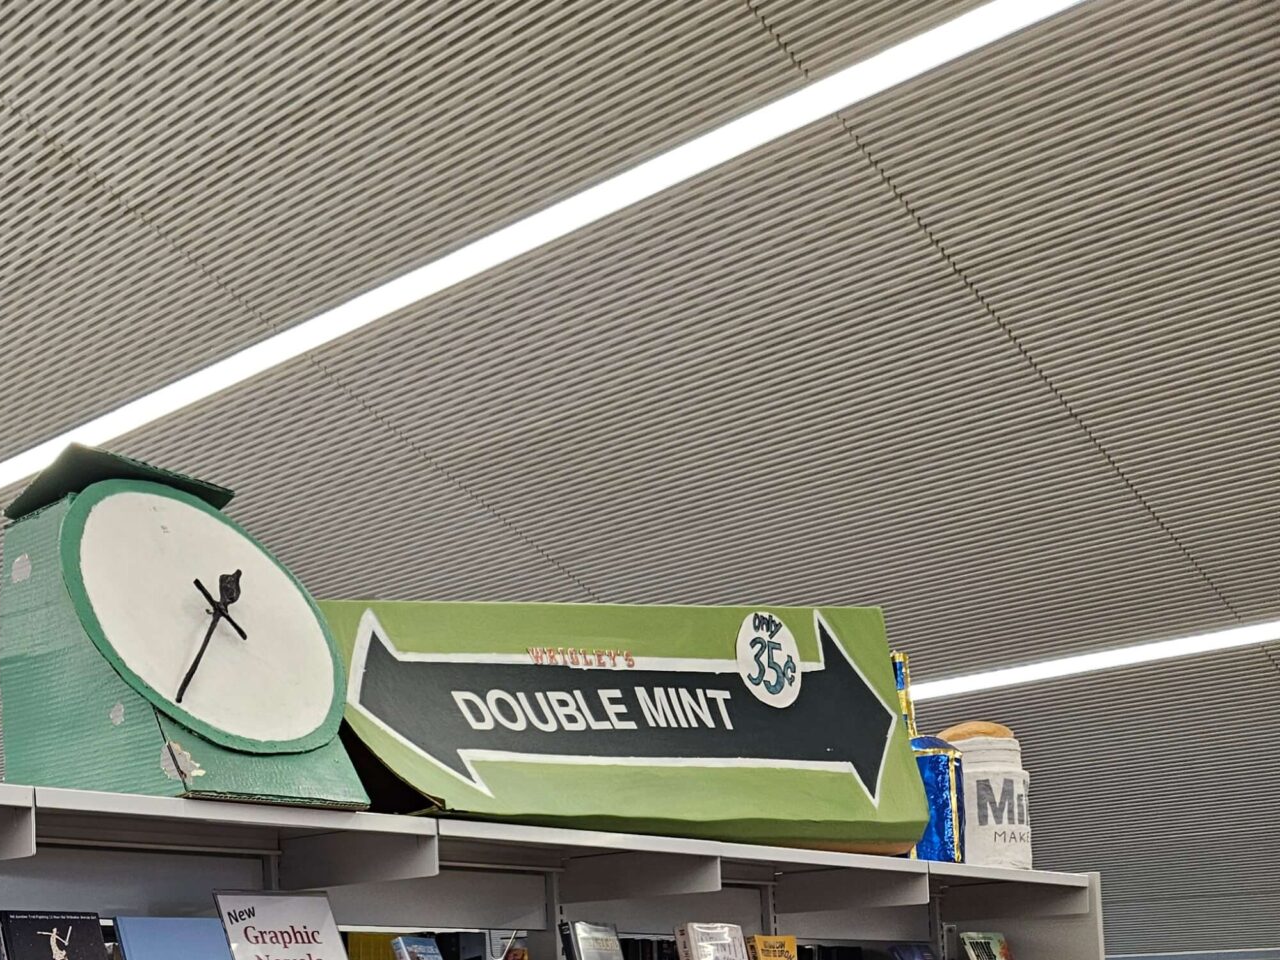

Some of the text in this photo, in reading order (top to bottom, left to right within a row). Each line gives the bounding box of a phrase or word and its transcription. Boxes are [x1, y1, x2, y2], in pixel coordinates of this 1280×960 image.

[747, 637, 796, 695] 35¢
[452, 686, 734, 731] DOUBLE MINT
[228, 906, 256, 924] New
[244, 926, 324, 946] Graphic
